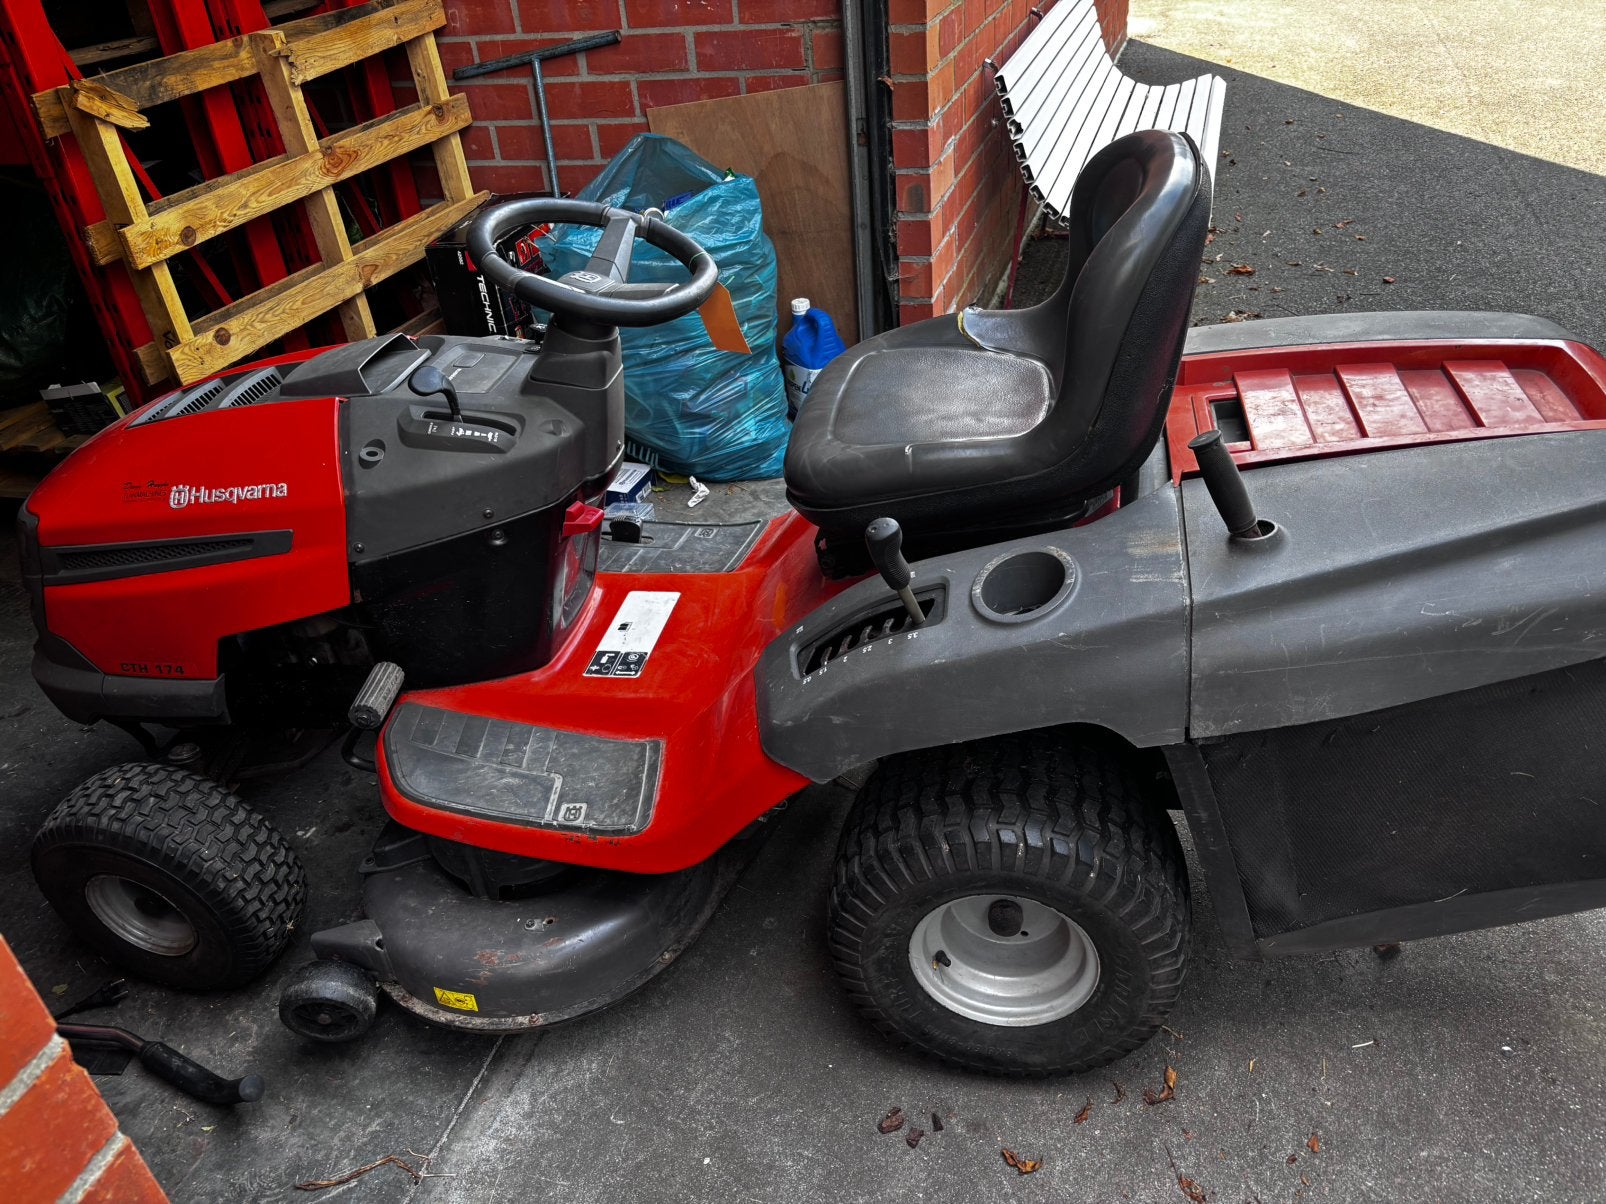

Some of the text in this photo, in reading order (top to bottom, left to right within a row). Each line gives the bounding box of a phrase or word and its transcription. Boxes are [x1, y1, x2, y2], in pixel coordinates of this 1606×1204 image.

[476, 274, 497, 333] TECHNIC
[189, 482, 288, 505] Husqvarna
[120, 663, 185, 675] CTH 174
